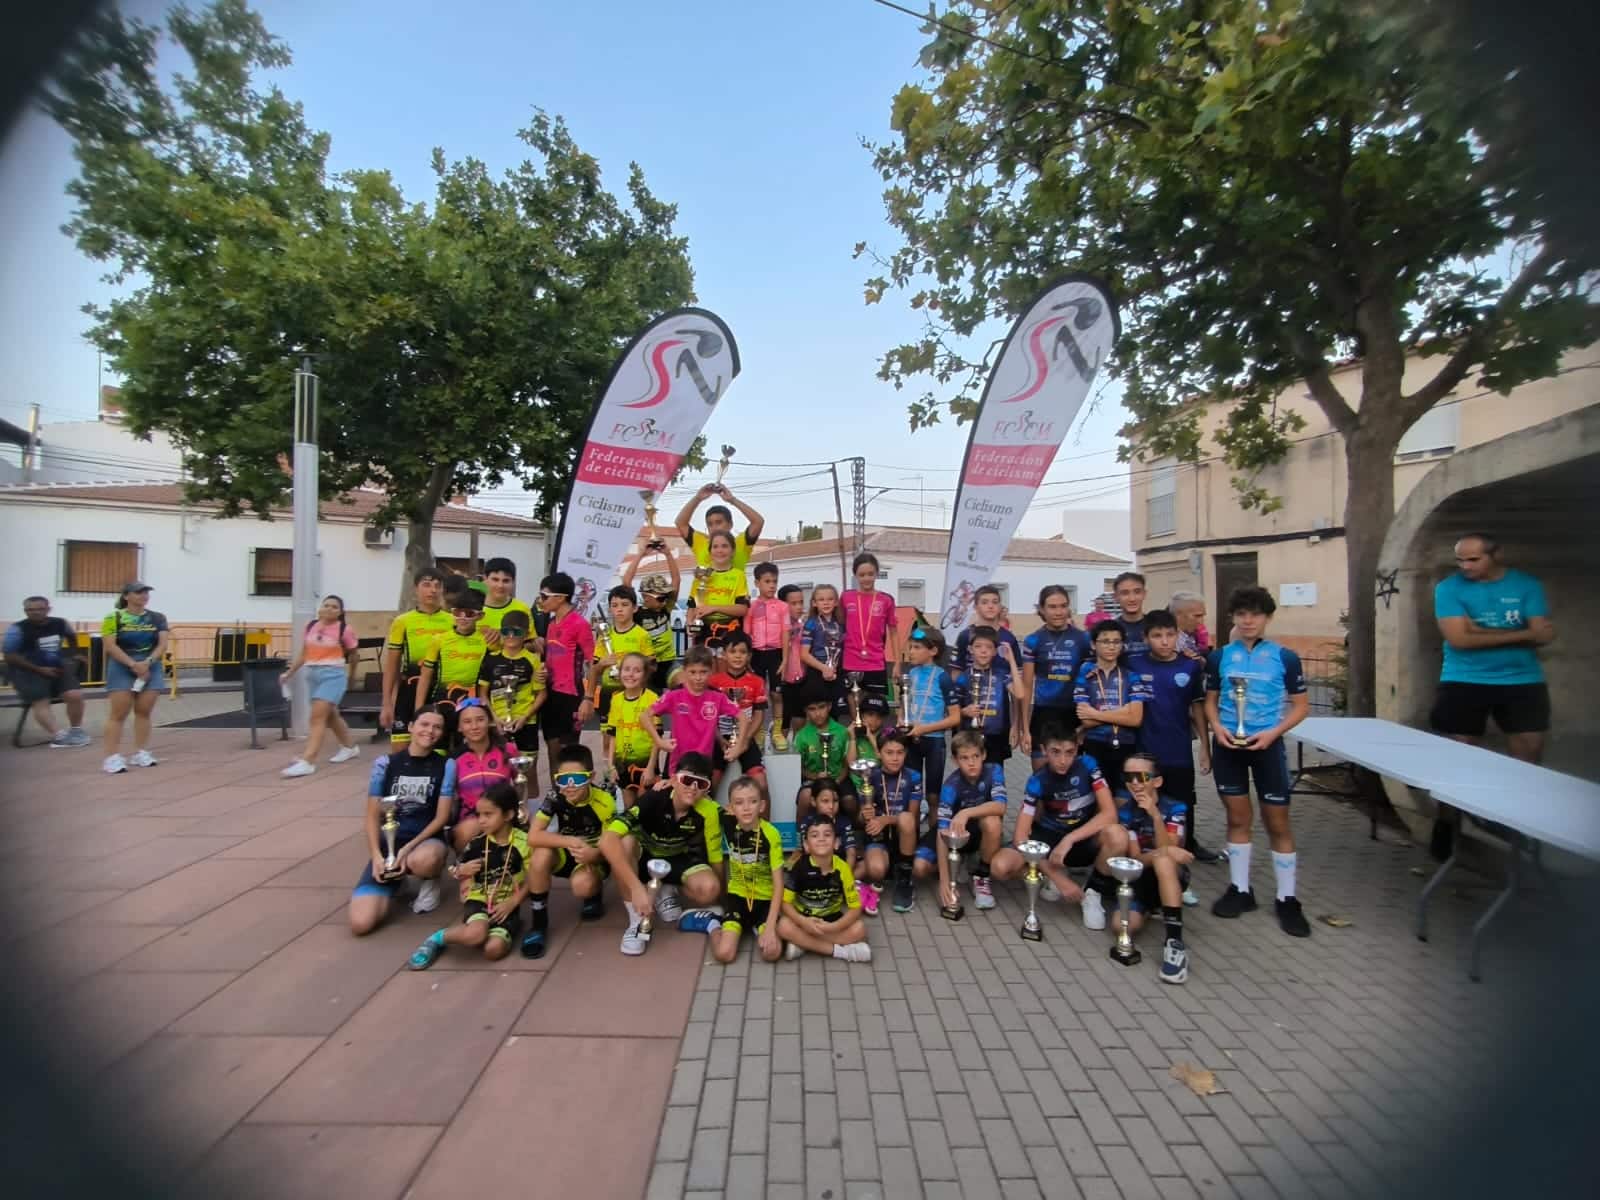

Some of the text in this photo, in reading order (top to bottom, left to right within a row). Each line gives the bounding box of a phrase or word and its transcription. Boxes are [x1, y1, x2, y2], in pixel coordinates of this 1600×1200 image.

[584, 460, 602, 473] de
[971, 462, 985, 475] de
[577, 494, 636, 516] Ciclismo
[964, 497, 1013, 514] Ciclismo
[583, 512, 624, 529] oficial
[967, 514, 1003, 530] oficial
